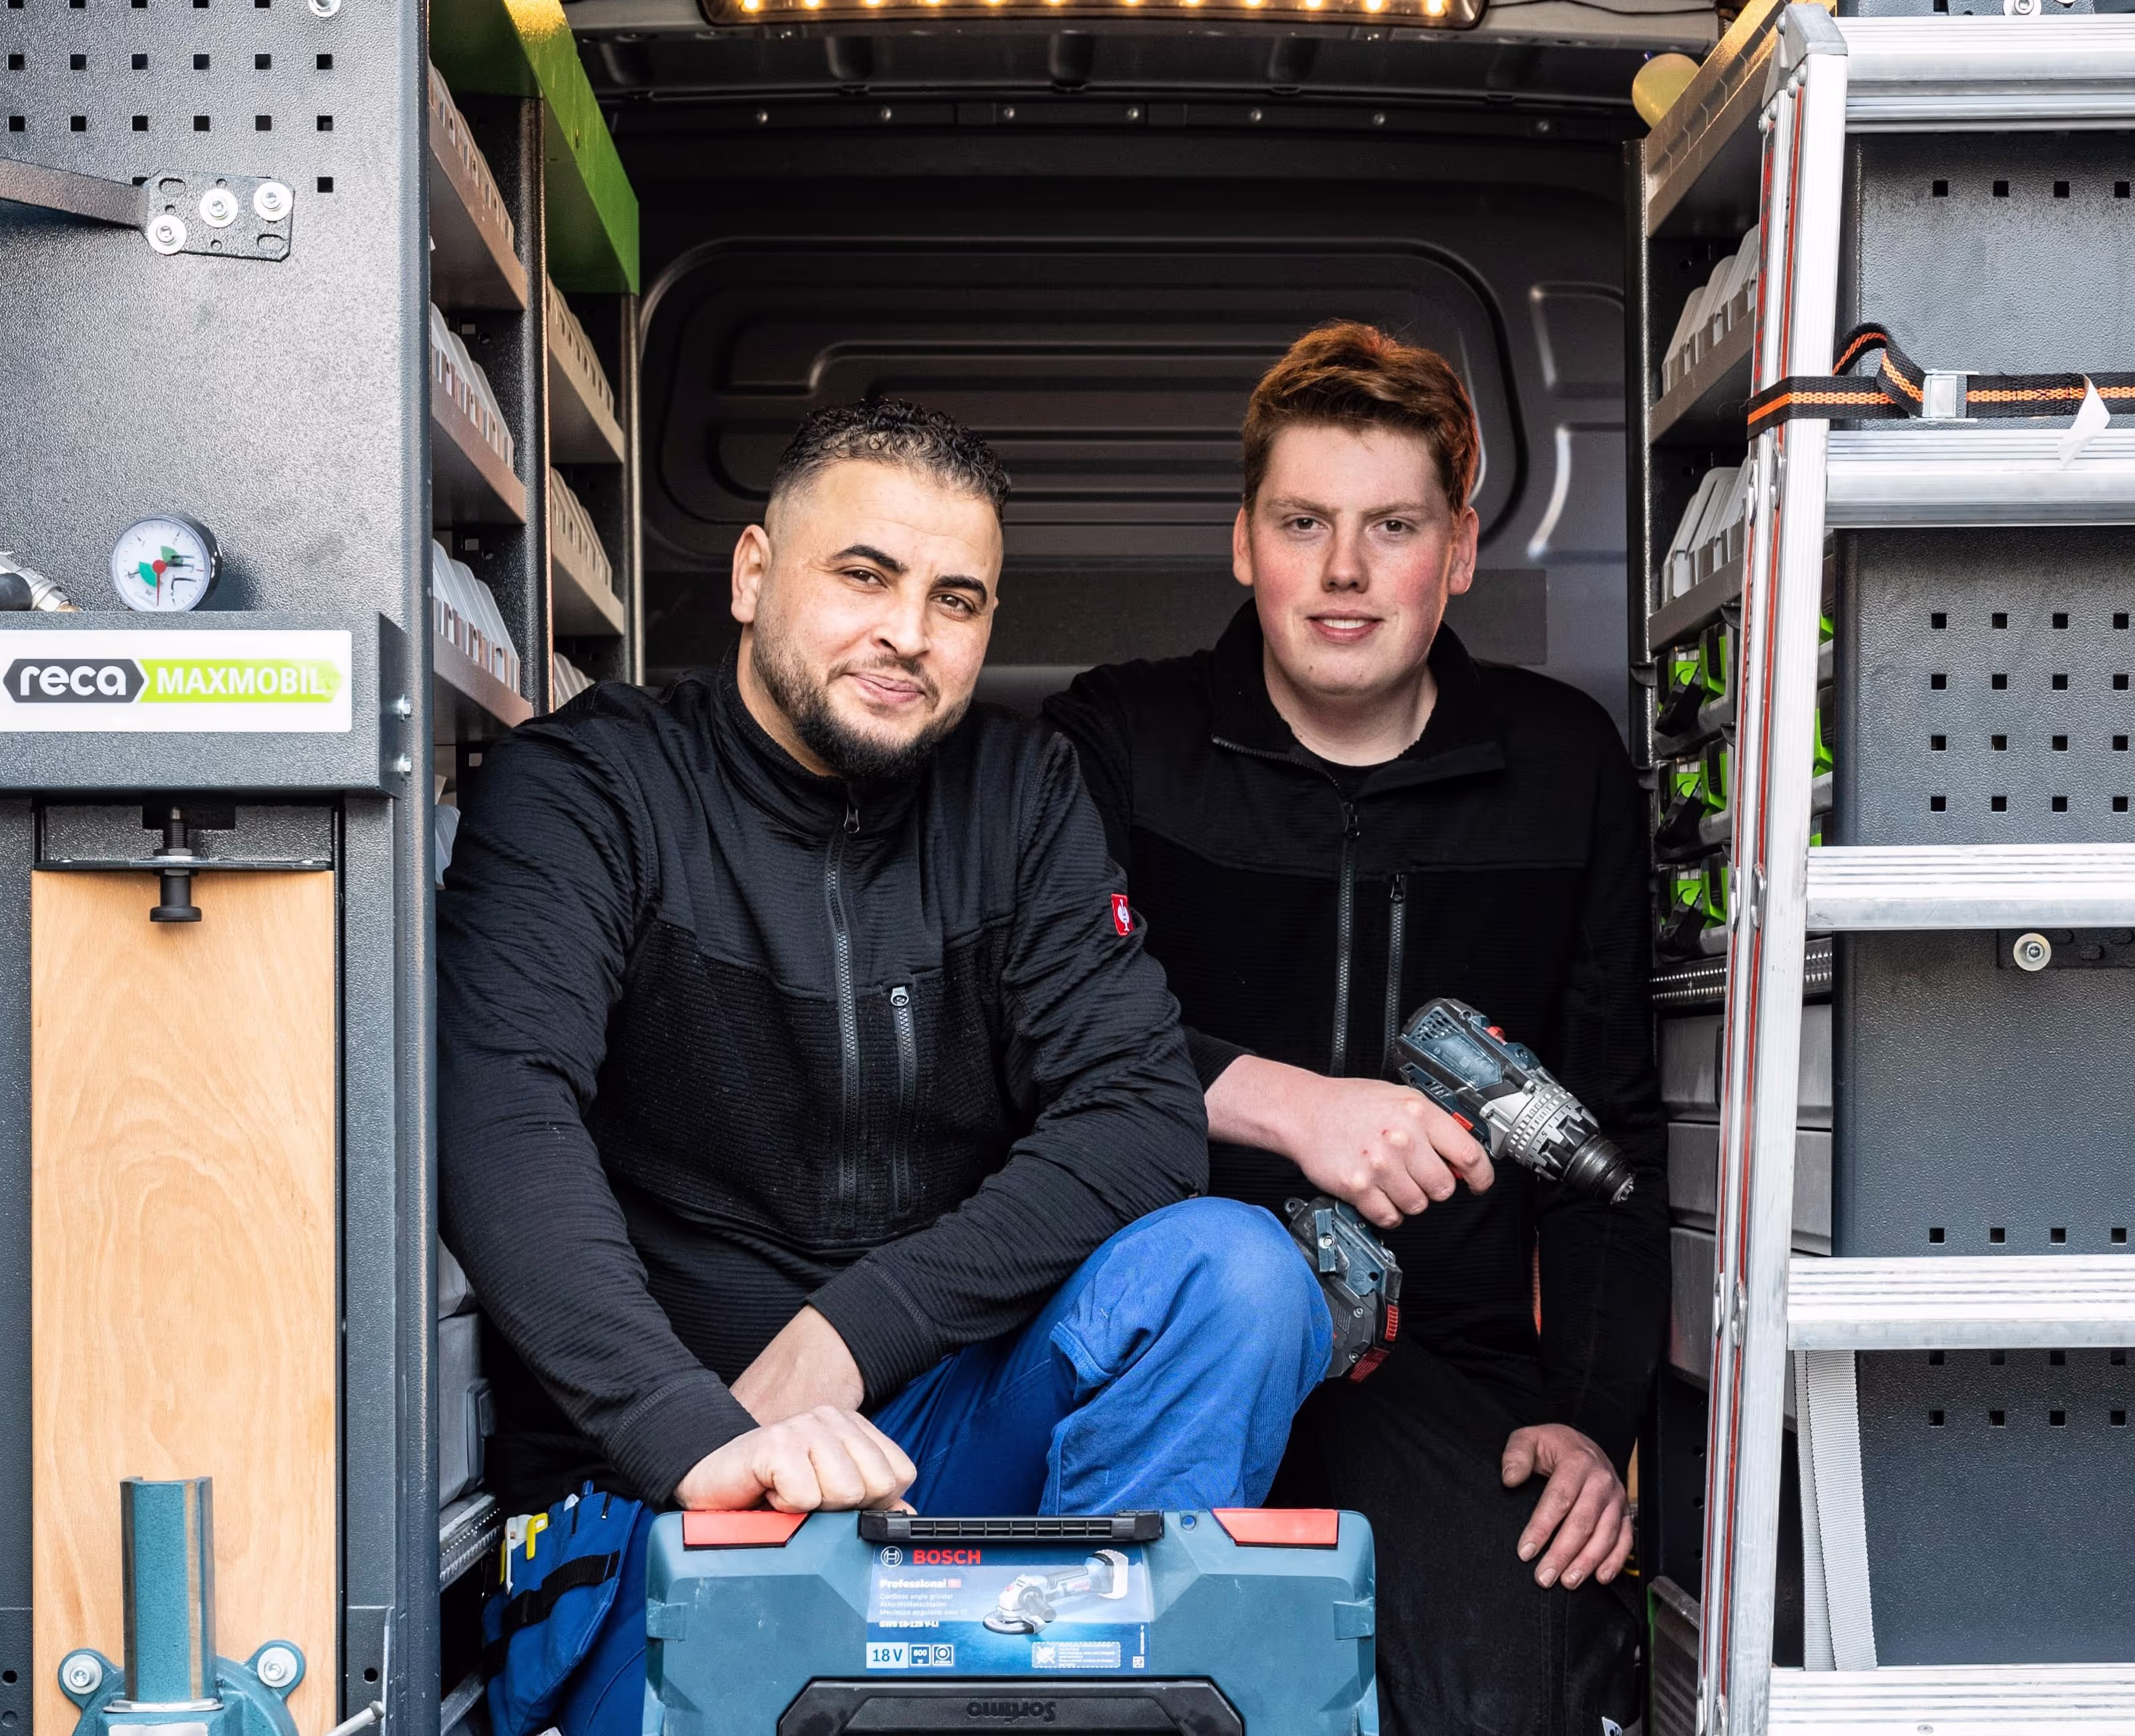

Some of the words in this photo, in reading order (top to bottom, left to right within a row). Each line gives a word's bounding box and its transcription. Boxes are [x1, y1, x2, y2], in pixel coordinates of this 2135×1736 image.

[19, 665, 127, 697] reca
[156, 666, 326, 696] MAXMOBIL
[912, 1548, 982, 1565] BOSCH
[879, 1578, 948, 1588] Professional
[929, 1593, 954, 1601] grinder
[879, 1620, 898, 1628] GWS
[872, 1649, 890, 1662] 18
[893, 1649, 903, 1662] V
[966, 1701, 1057, 1725] Sortimo
